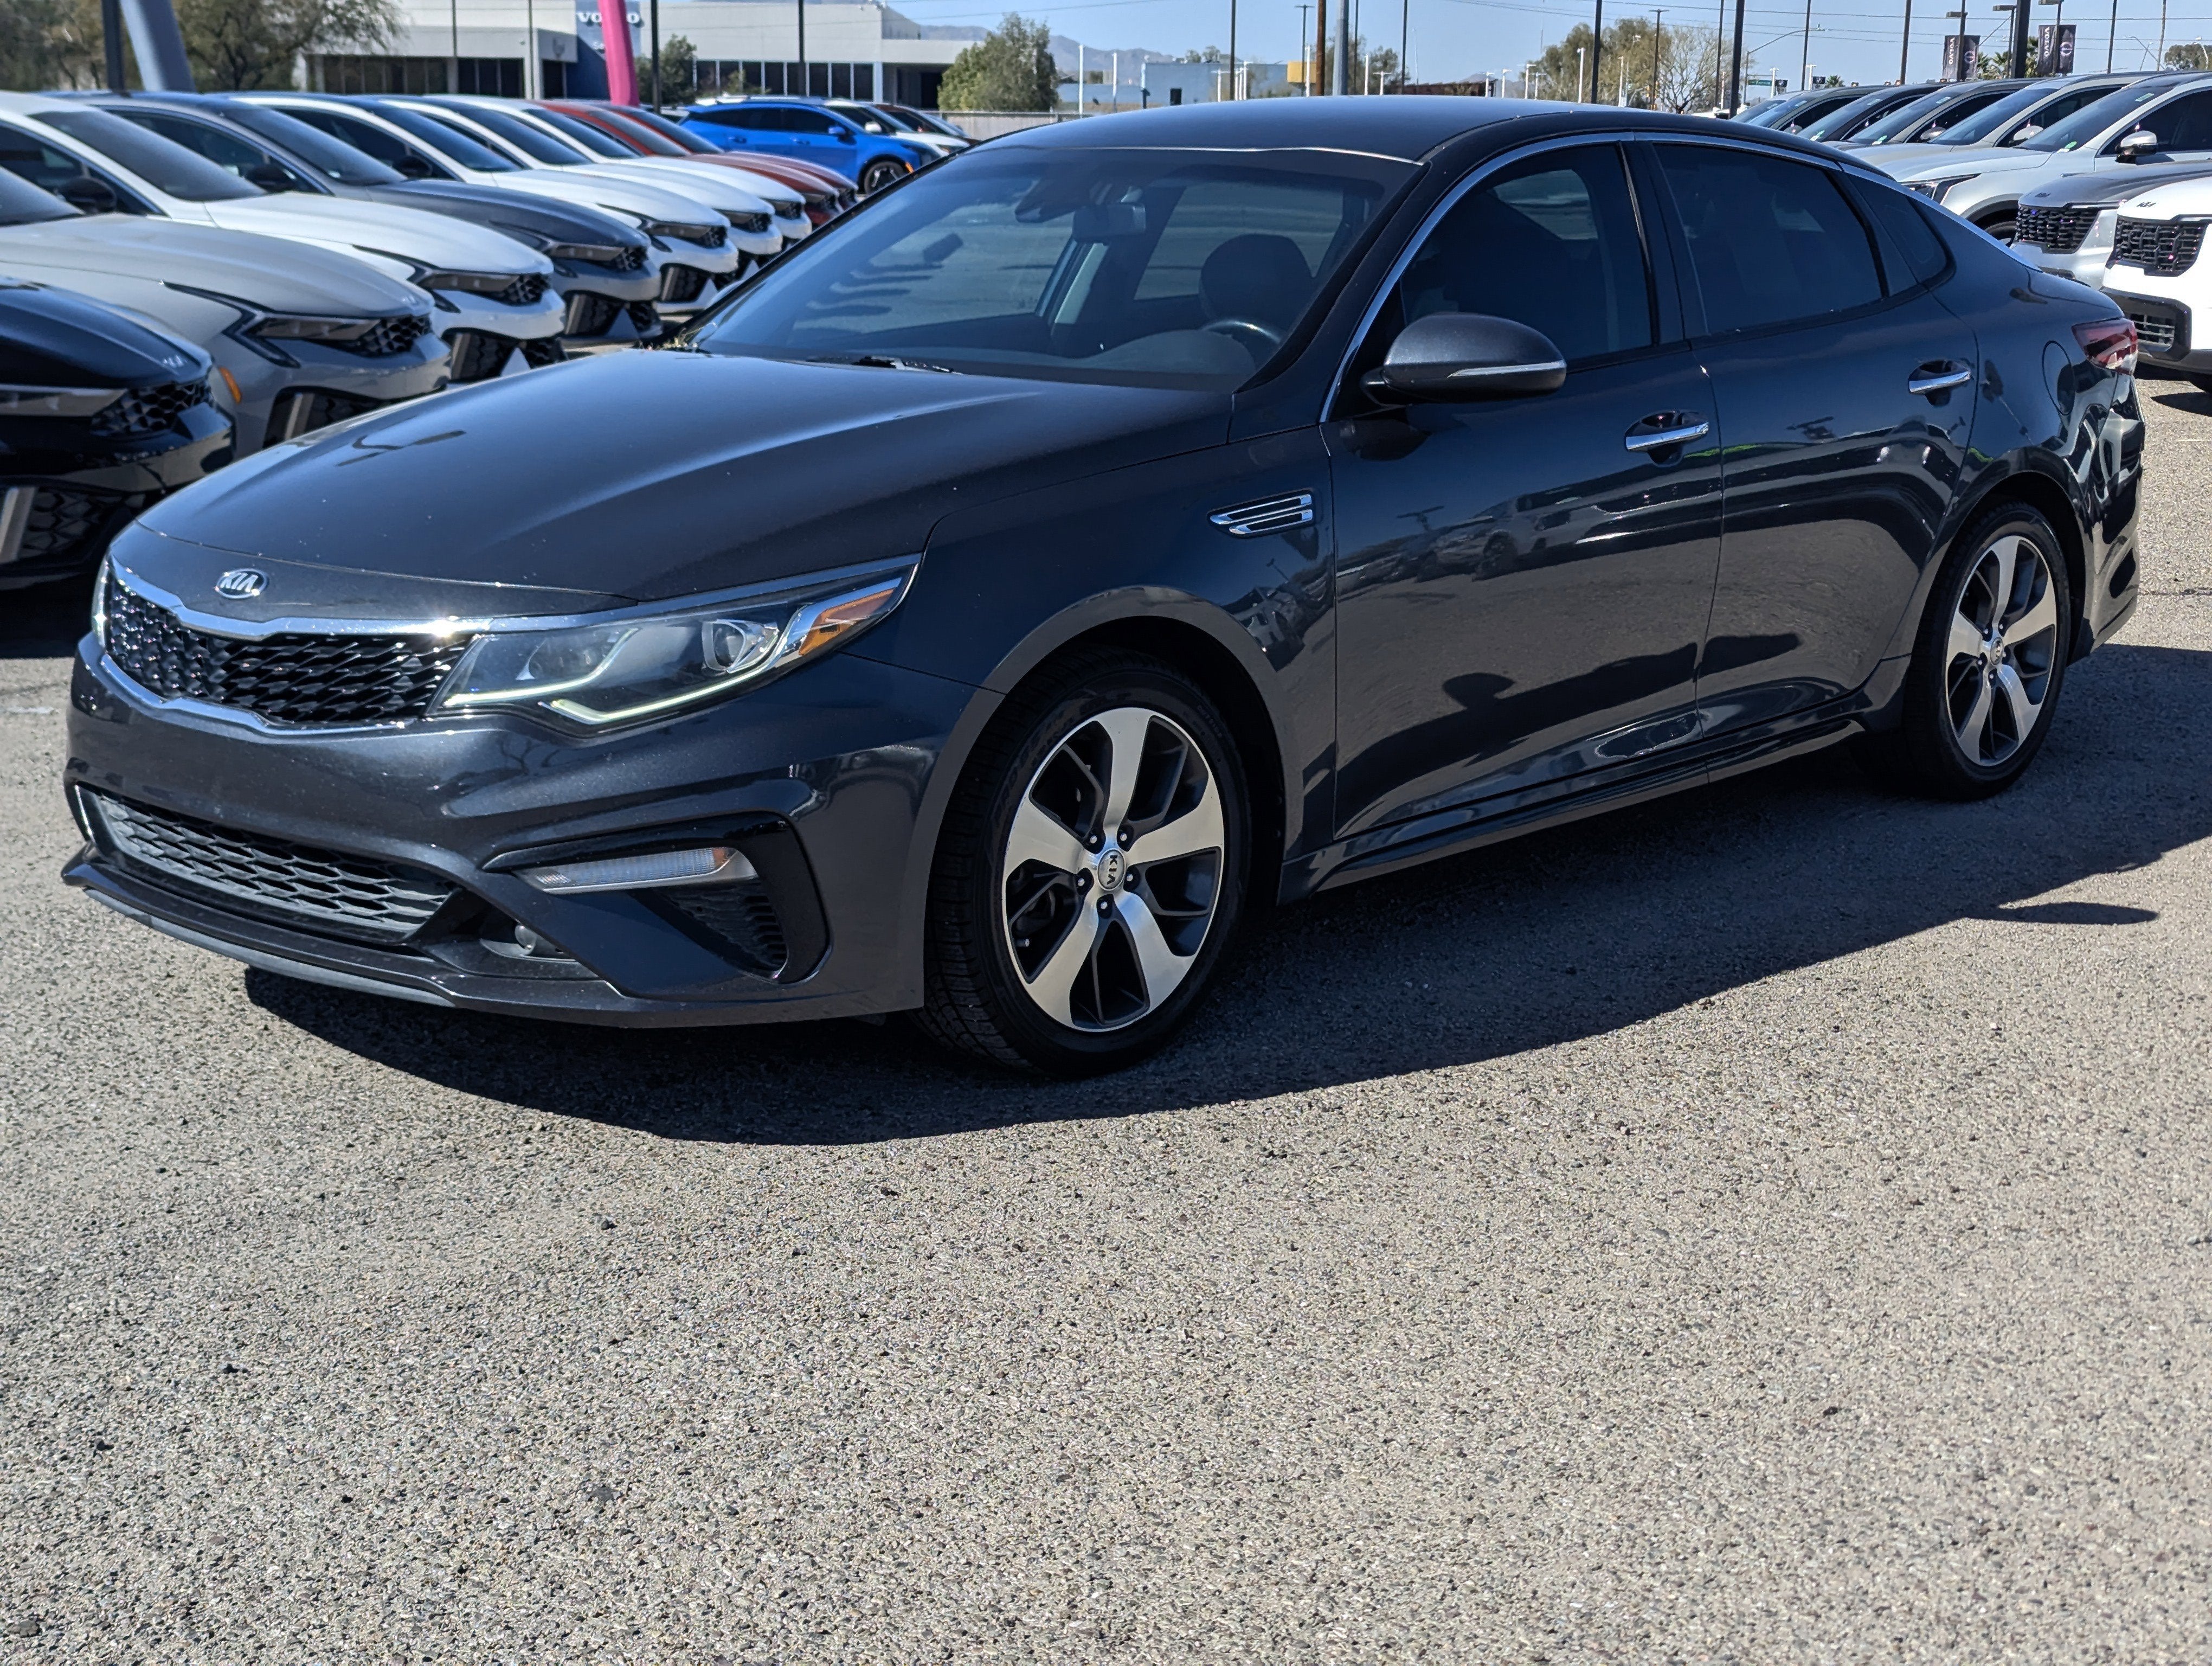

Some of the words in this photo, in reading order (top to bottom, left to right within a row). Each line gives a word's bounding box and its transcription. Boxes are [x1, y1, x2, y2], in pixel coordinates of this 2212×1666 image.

[576, 11, 640, 23] VOO
[220, 572, 259, 593] KIA
[1107, 855, 1118, 885] KIA
